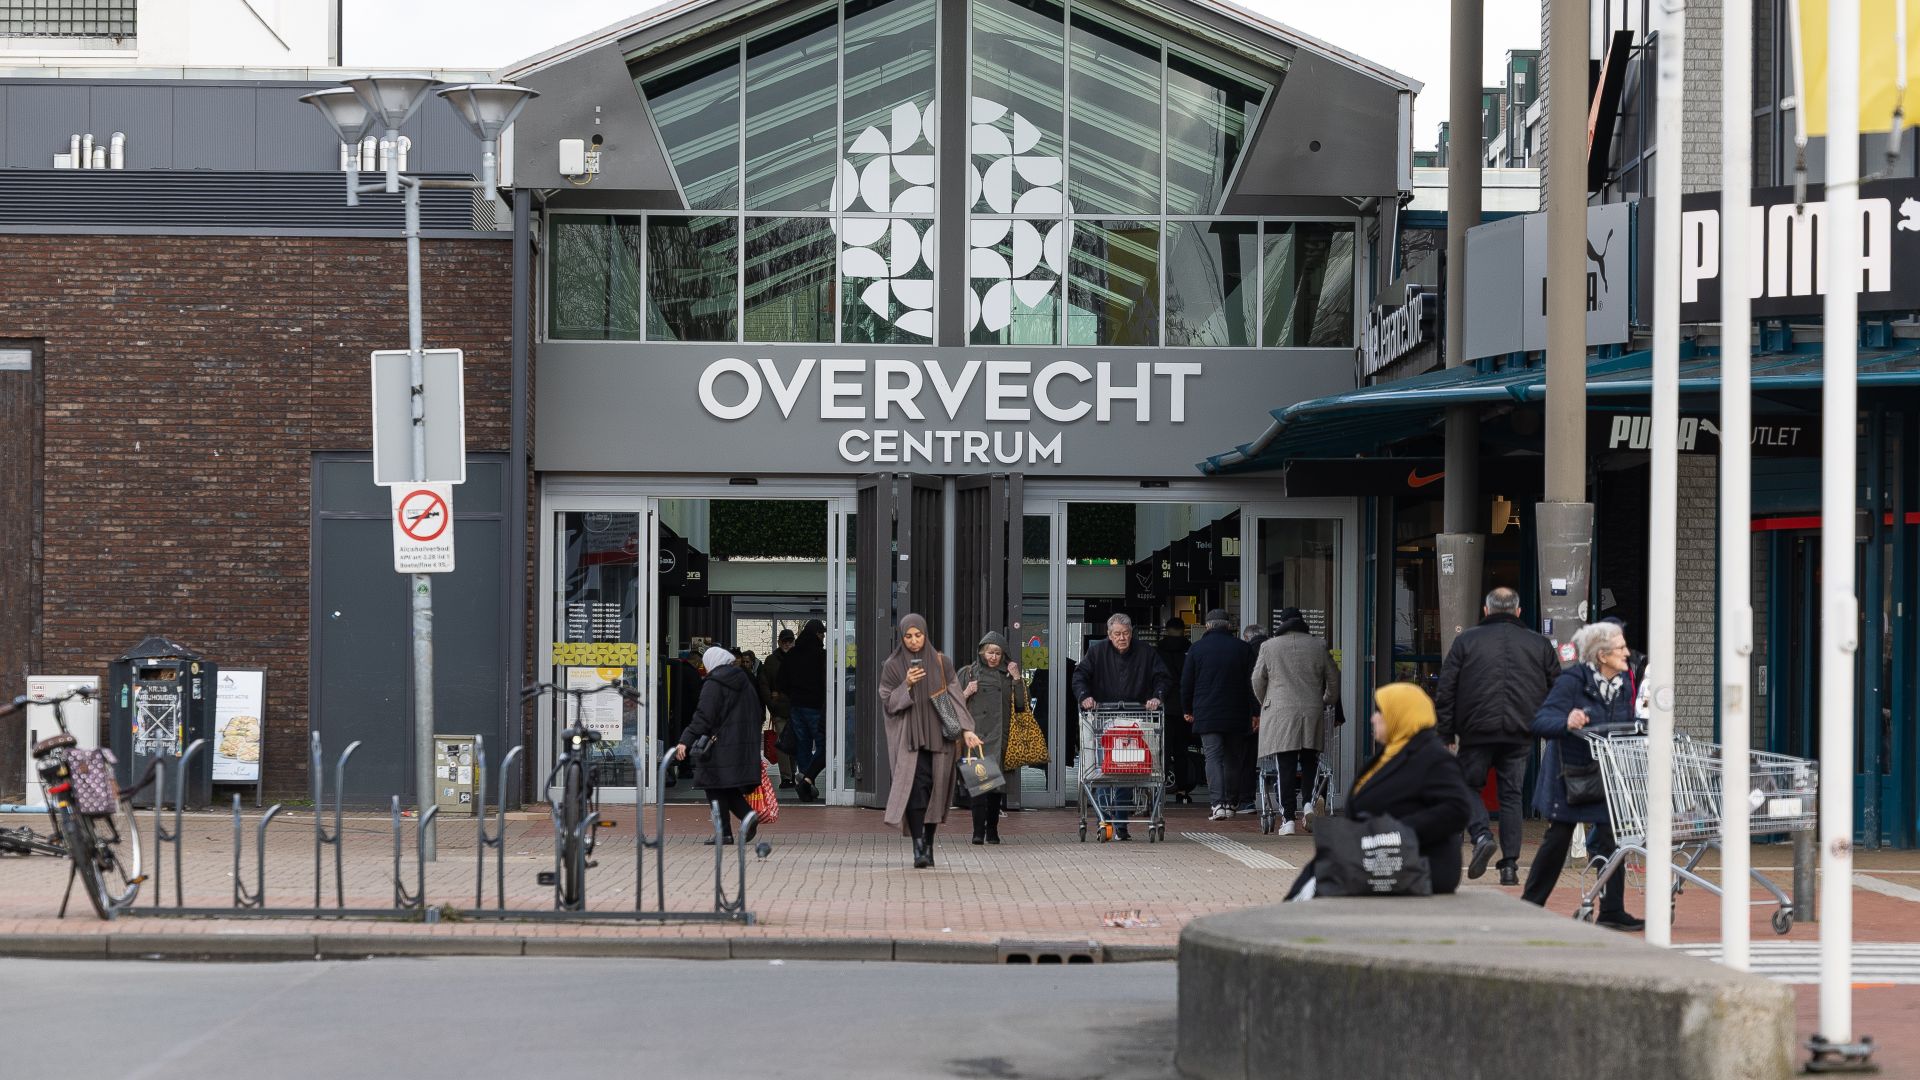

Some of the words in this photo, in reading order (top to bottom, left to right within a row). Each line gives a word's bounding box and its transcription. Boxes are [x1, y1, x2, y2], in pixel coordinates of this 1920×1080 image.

[1404, 284, 1423, 352] Store
[698, 357, 1203, 423] OVERVECHT
[838, 429, 1063, 464] CENTRUM
[1609, 415, 1699, 450] PUA
